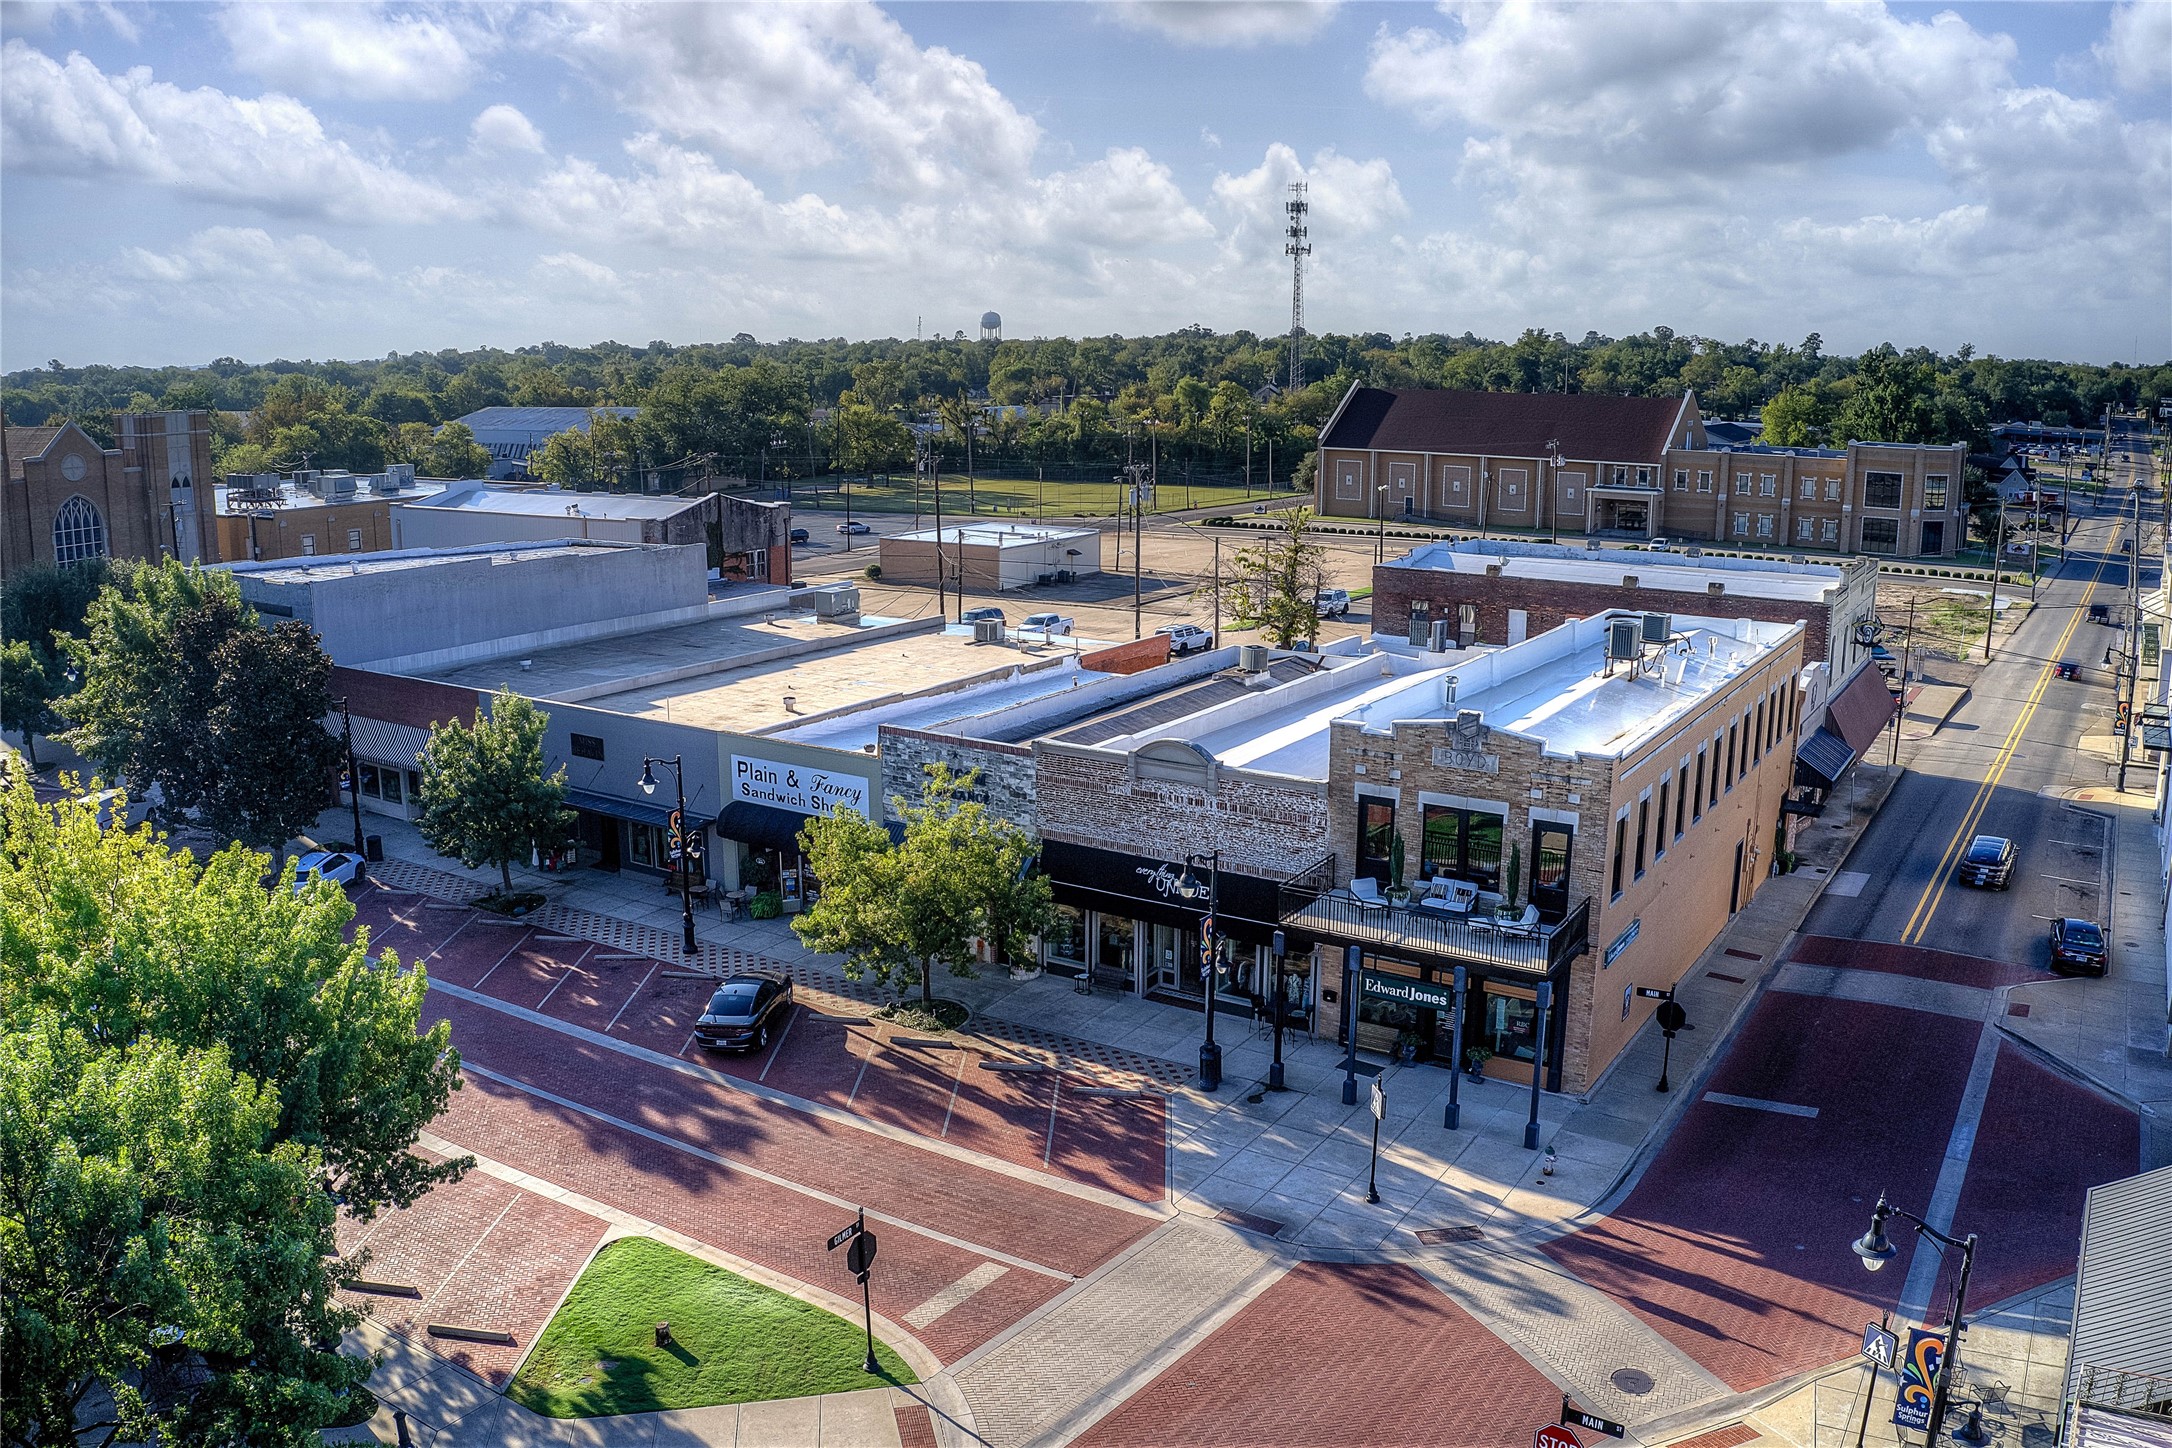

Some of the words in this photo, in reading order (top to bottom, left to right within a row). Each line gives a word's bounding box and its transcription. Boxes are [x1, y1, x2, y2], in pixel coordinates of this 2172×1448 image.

[1444, 751, 1487, 769] BOYD
[737, 761, 777, 785] Plain
[786, 769, 800, 789] &
[810, 774, 862, 806] Fancy
[741, 782, 806, 808] Sandwich
[1645, 989, 1660, 998] MAIN
[833, 1227, 853, 1246] GILMER
[1896, 1403, 1929, 1418] Sulphur
[1897, 1411, 1925, 1425] Springs
[1581, 1414, 1604, 1431] MAIN
[1615, 1425, 1623, 1433] ST
[1538, 1434, 1578, 1448] ST
